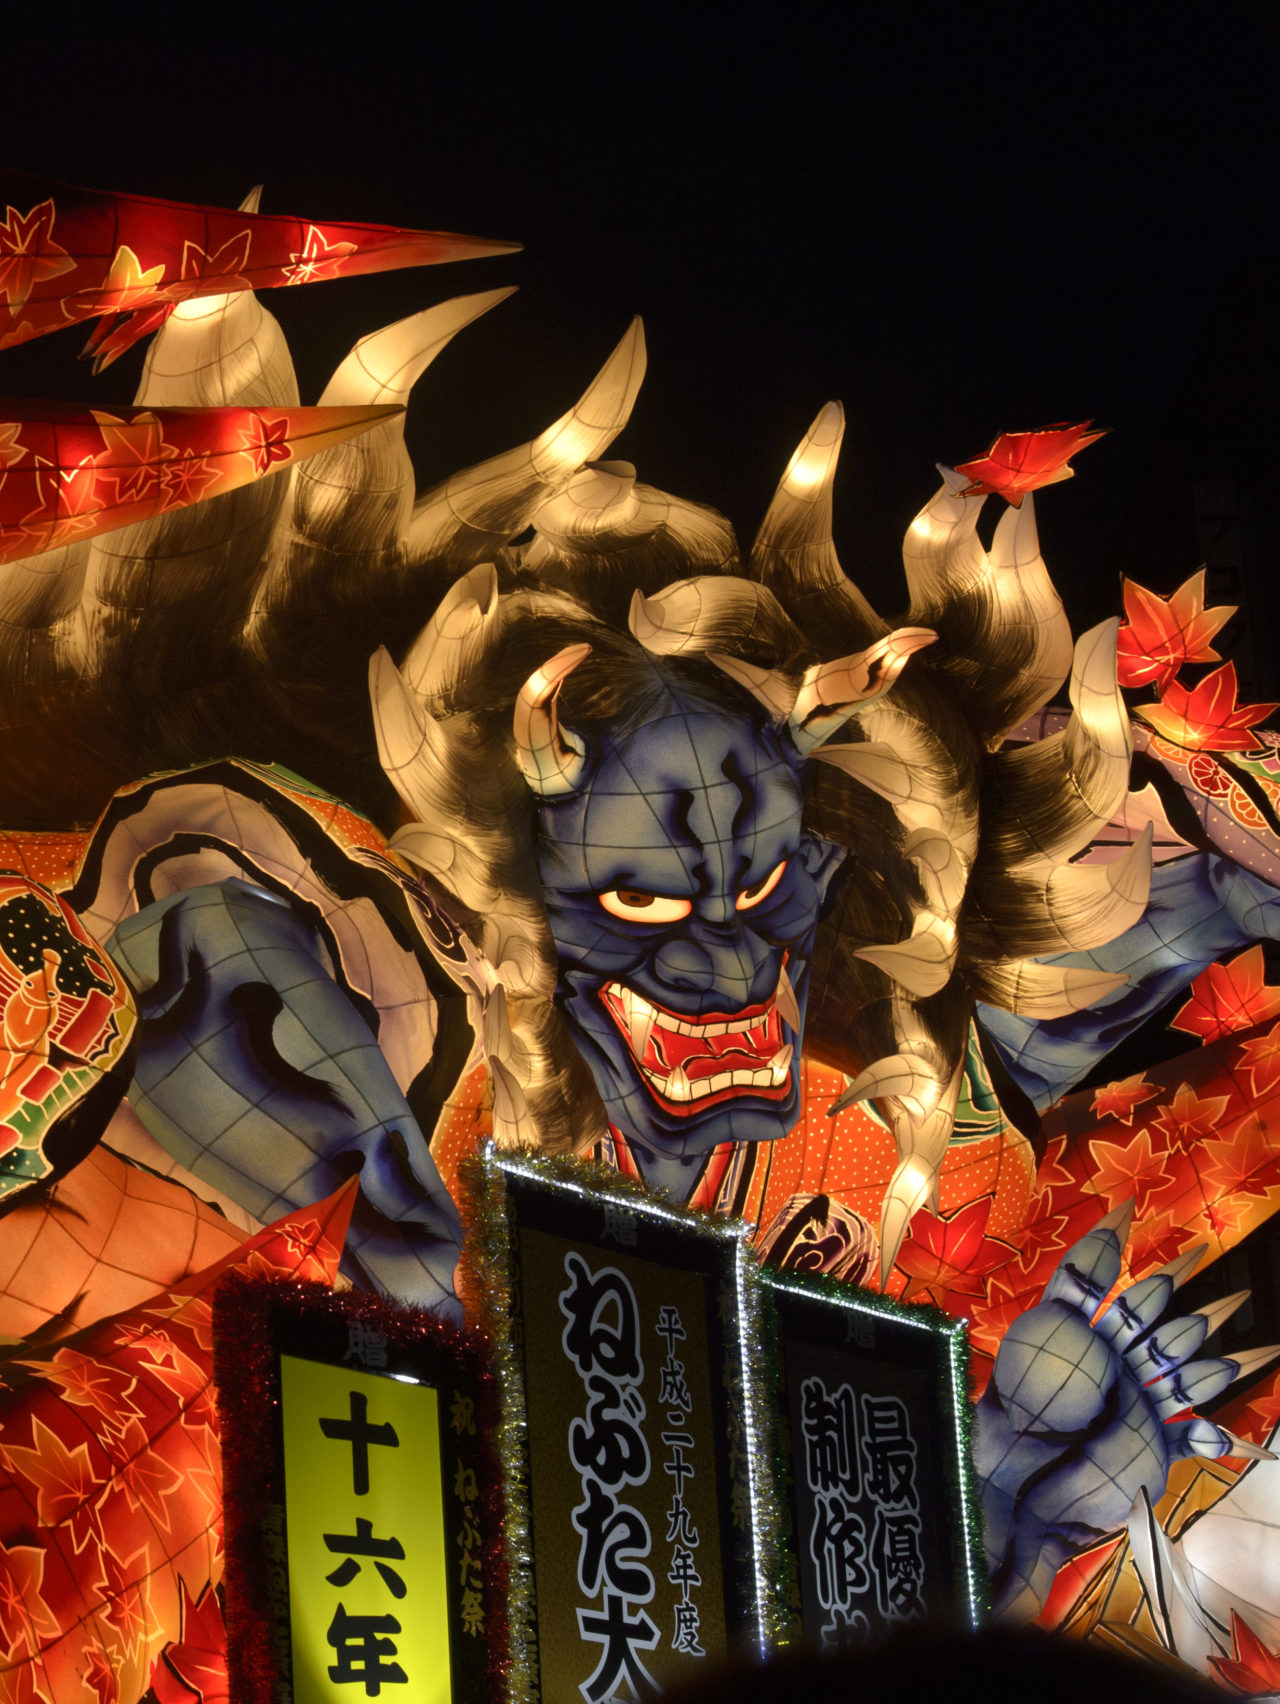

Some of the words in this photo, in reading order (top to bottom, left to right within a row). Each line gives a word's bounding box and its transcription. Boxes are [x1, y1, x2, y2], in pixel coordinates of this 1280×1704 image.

[449, 1387, 477, 1437] 祝
[656, 1306, 706, 1656] 平成二十九年度
[318, 1390, 410, 1697] 十六年
[453, 1457, 486, 1639] ねぶた祭
